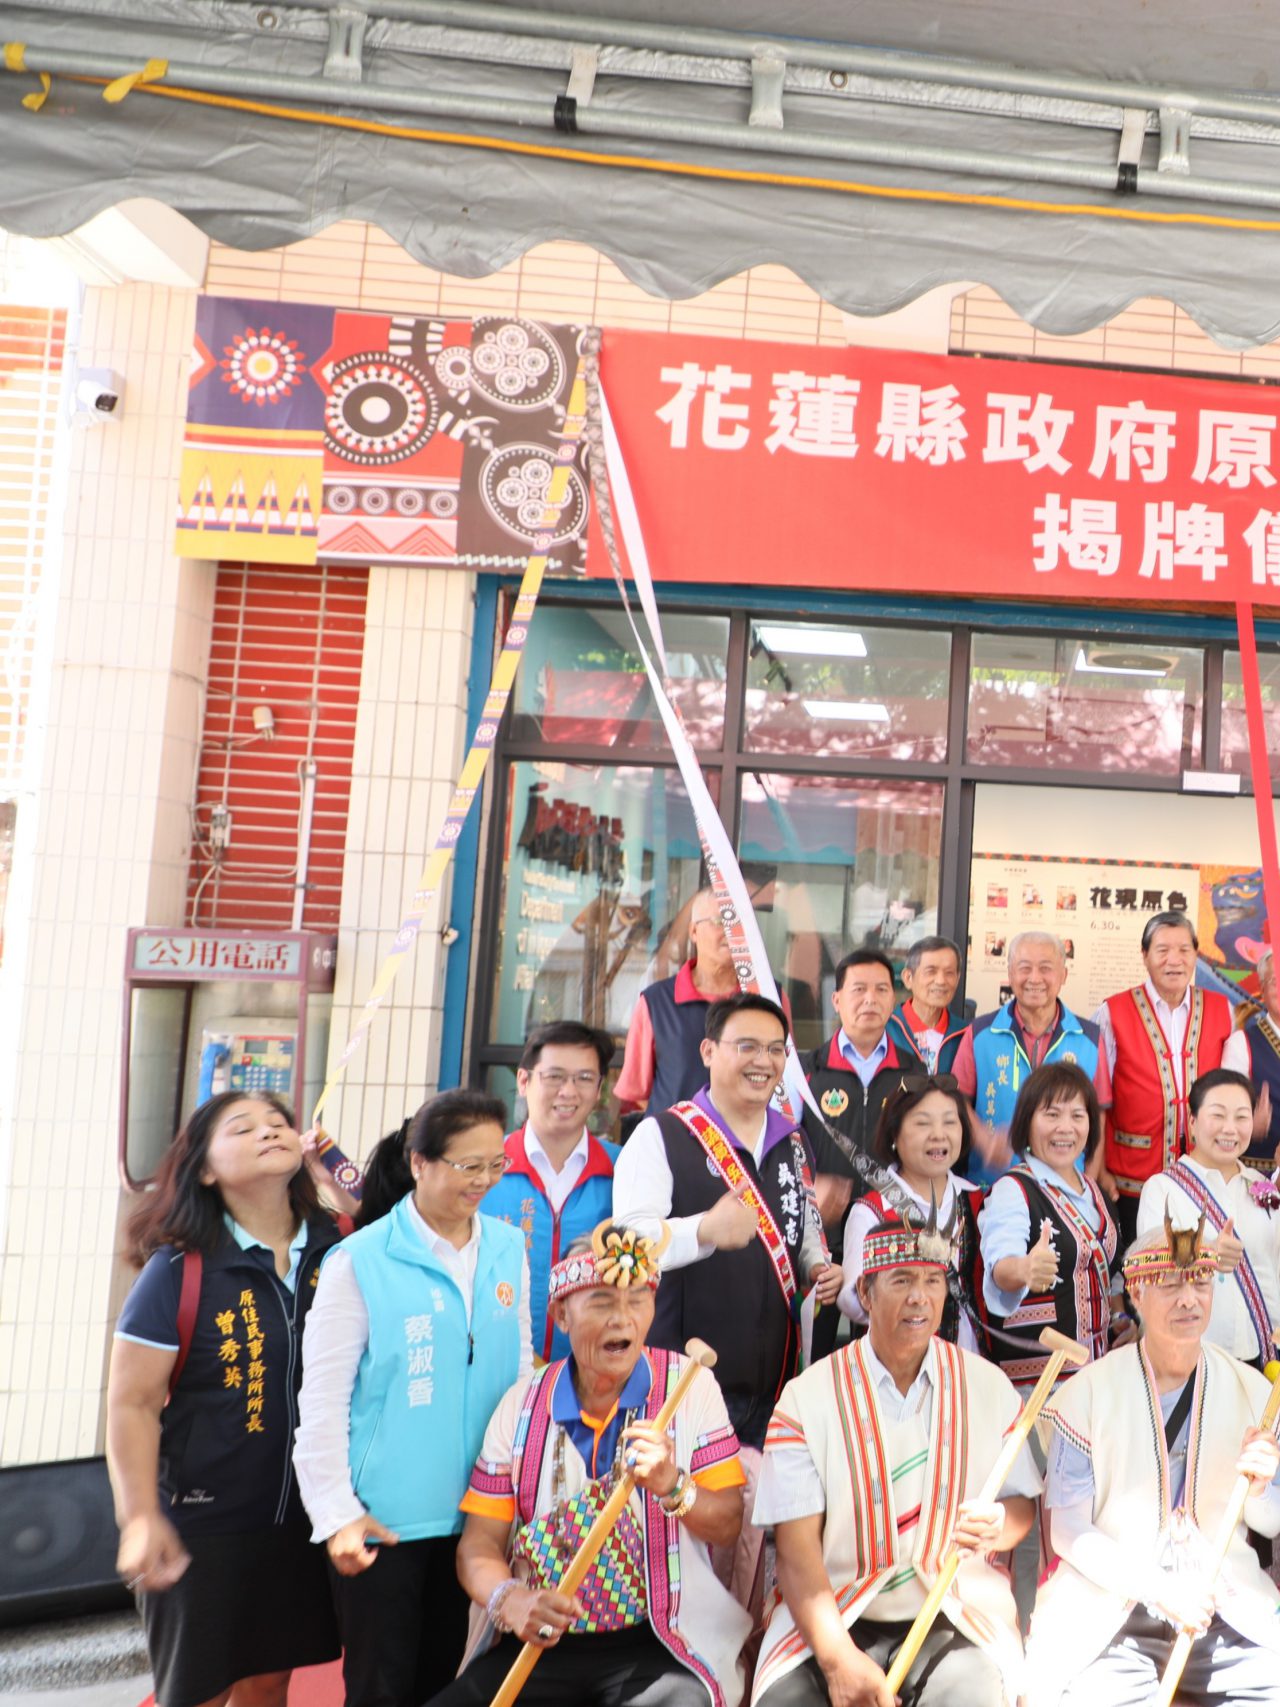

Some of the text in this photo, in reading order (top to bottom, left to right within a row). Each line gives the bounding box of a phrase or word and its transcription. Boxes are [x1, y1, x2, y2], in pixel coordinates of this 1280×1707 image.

[1089, 885, 1188, 912] 花現原色
[148, 939, 290, 971] 公用電話
[778, 1162, 800, 1246] 吳建志
[214, 1311, 242, 1390] 曾秀英
[238, 1288, 267, 1433] 原住民事務所所長
[404, 1313, 434, 1409] 蔡淑香
